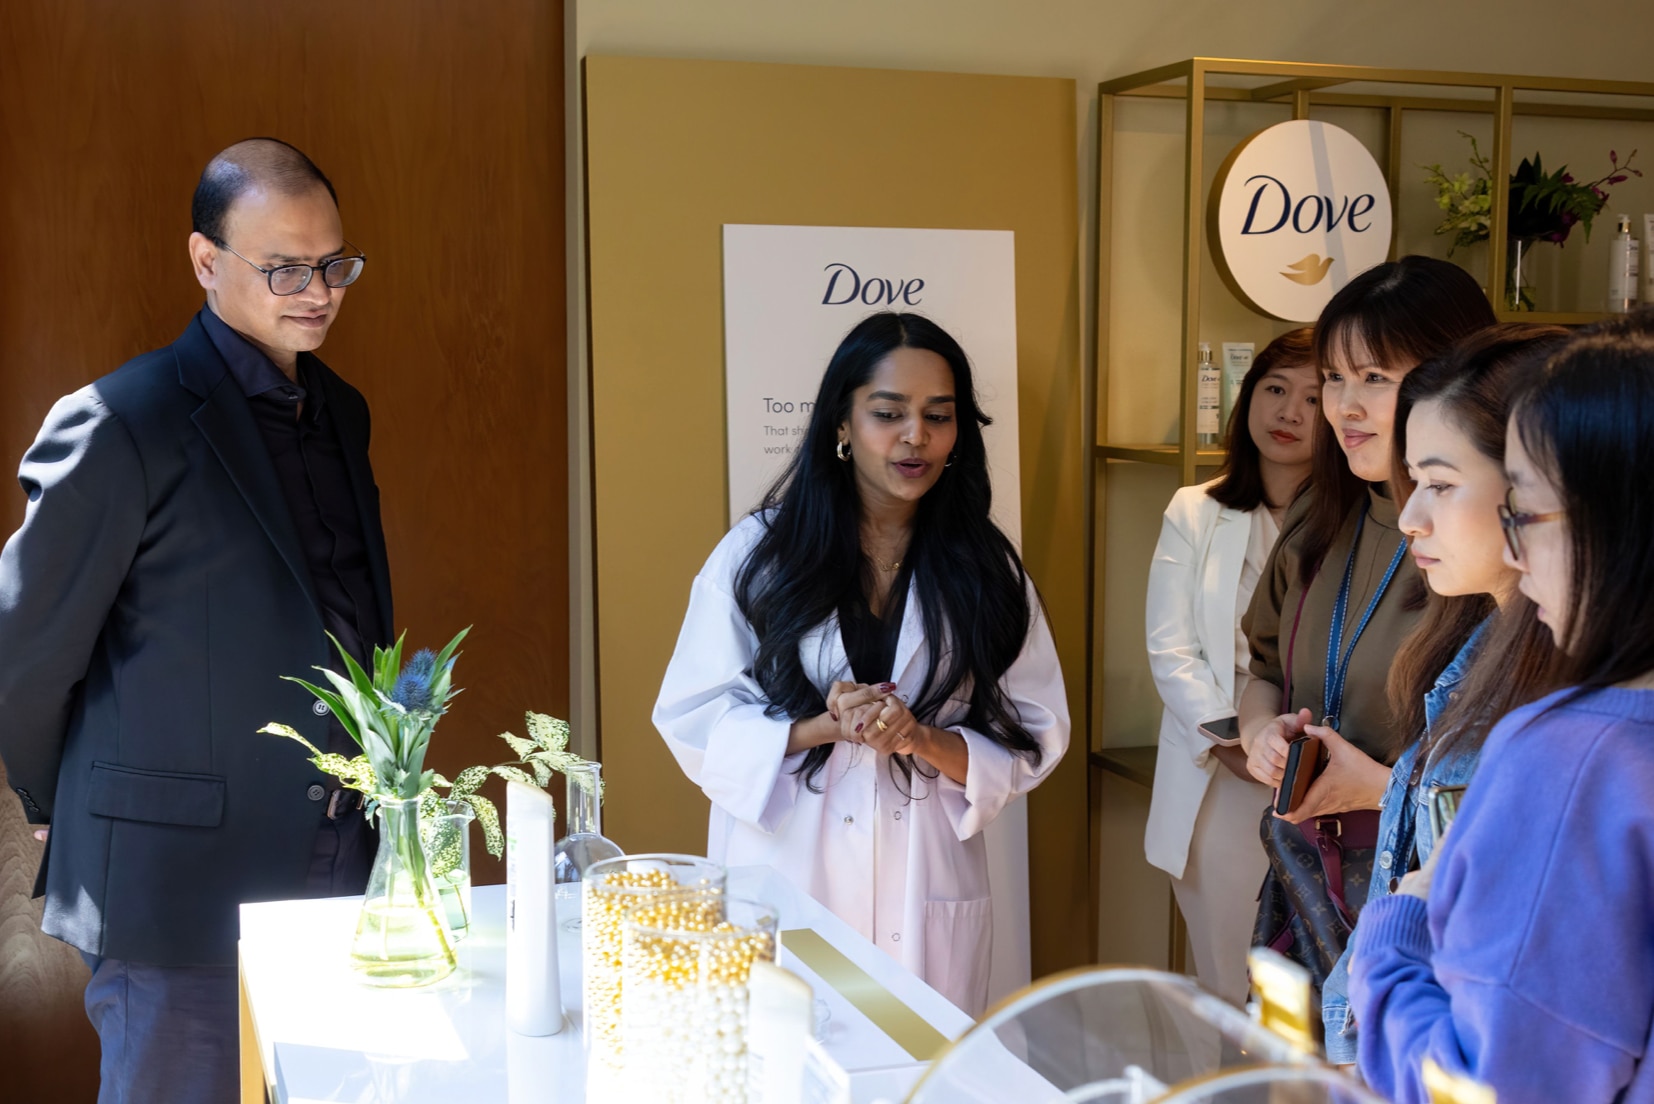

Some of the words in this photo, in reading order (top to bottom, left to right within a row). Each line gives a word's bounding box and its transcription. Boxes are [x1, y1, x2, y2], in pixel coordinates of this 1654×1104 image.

[1240, 174, 1375, 235] Dove
[821, 263, 925, 306] Dove
[762, 397, 795, 413] Too
[800, 401, 817, 413] m
[763, 425, 788, 436] That
[763, 444, 792, 455] work
